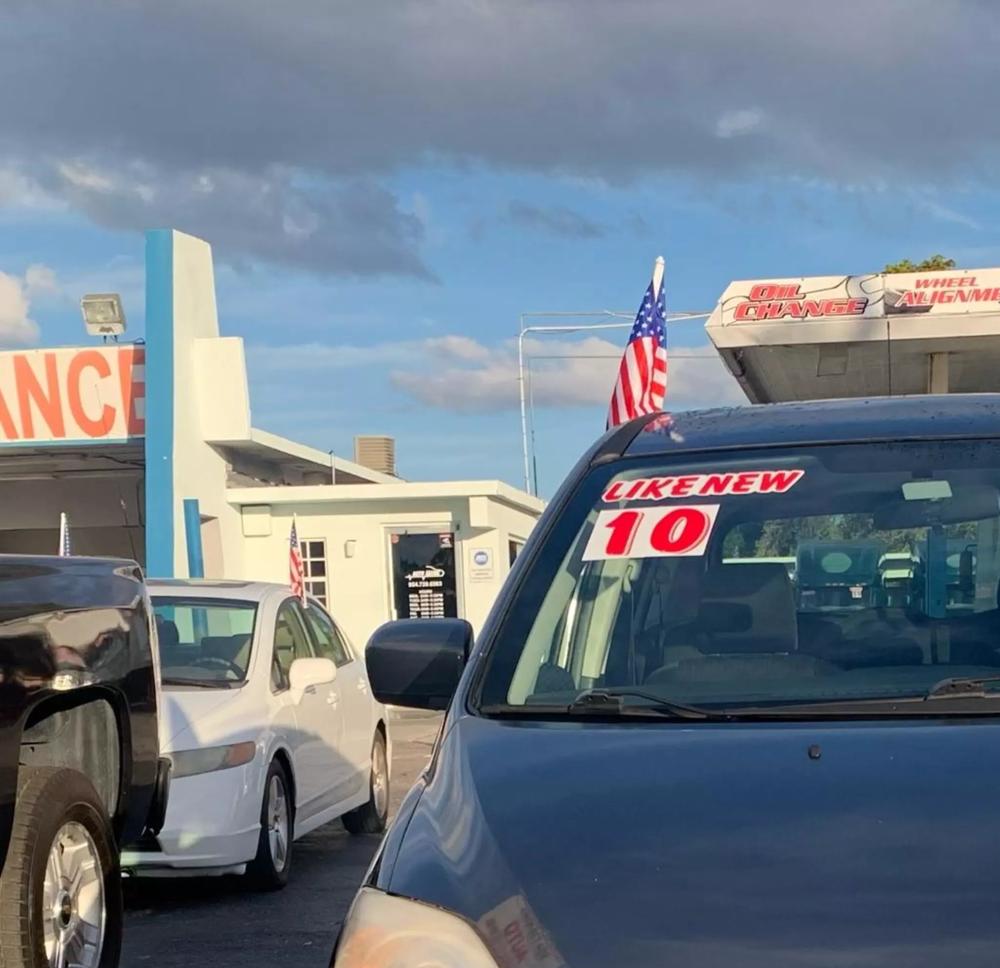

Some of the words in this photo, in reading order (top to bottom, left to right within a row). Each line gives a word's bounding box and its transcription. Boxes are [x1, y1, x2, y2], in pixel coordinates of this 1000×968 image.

[749, 284, 806, 300] OIL
[915, 277, 979, 289] WHEEL
[733, 297, 868, 321] CHANGE
[604, 477, 699, 501] LIKE
[699, 471, 801, 495] NEW
[605, 508, 711, 555] 10
